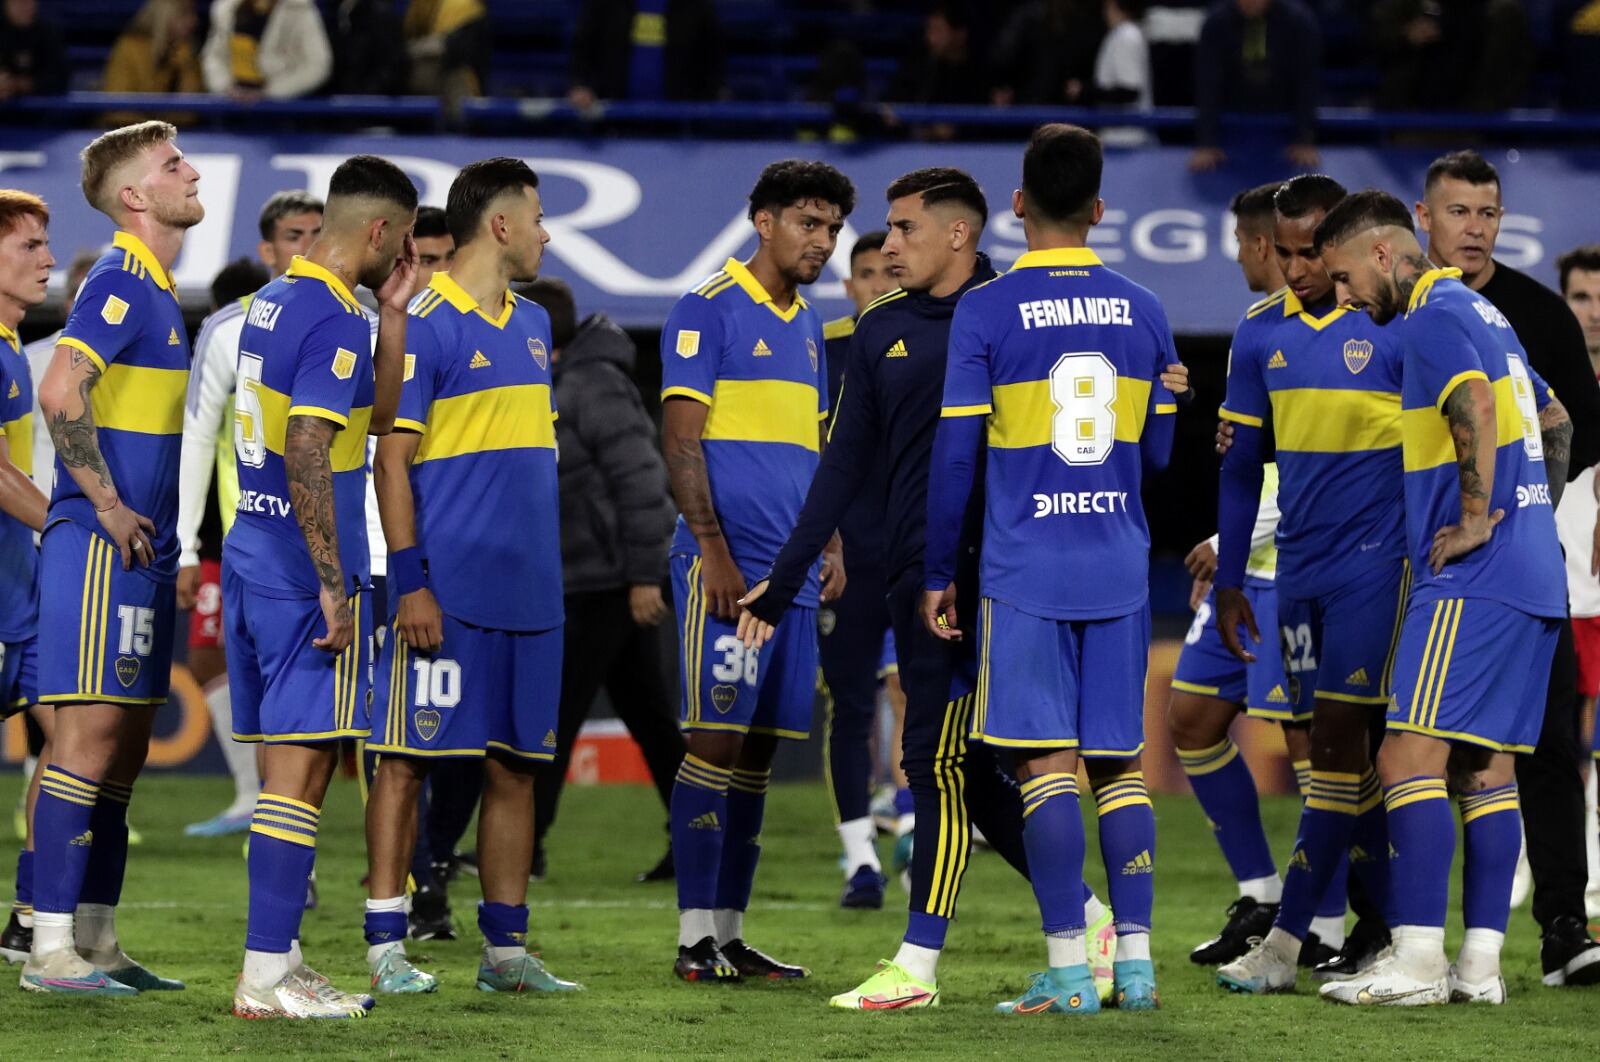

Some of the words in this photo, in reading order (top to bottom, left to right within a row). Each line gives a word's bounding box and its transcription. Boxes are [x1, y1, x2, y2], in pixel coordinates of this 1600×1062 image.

[1018, 296, 1133, 330] FERNANDEZ
[235, 350, 266, 469] 5
[1049, 352, 1117, 466] 8
[1033, 491, 1128, 518] DIRECTV
[1516, 483, 1552, 508] DIREC
[117, 604, 155, 657] 15
[413, 656, 462, 708] 10
